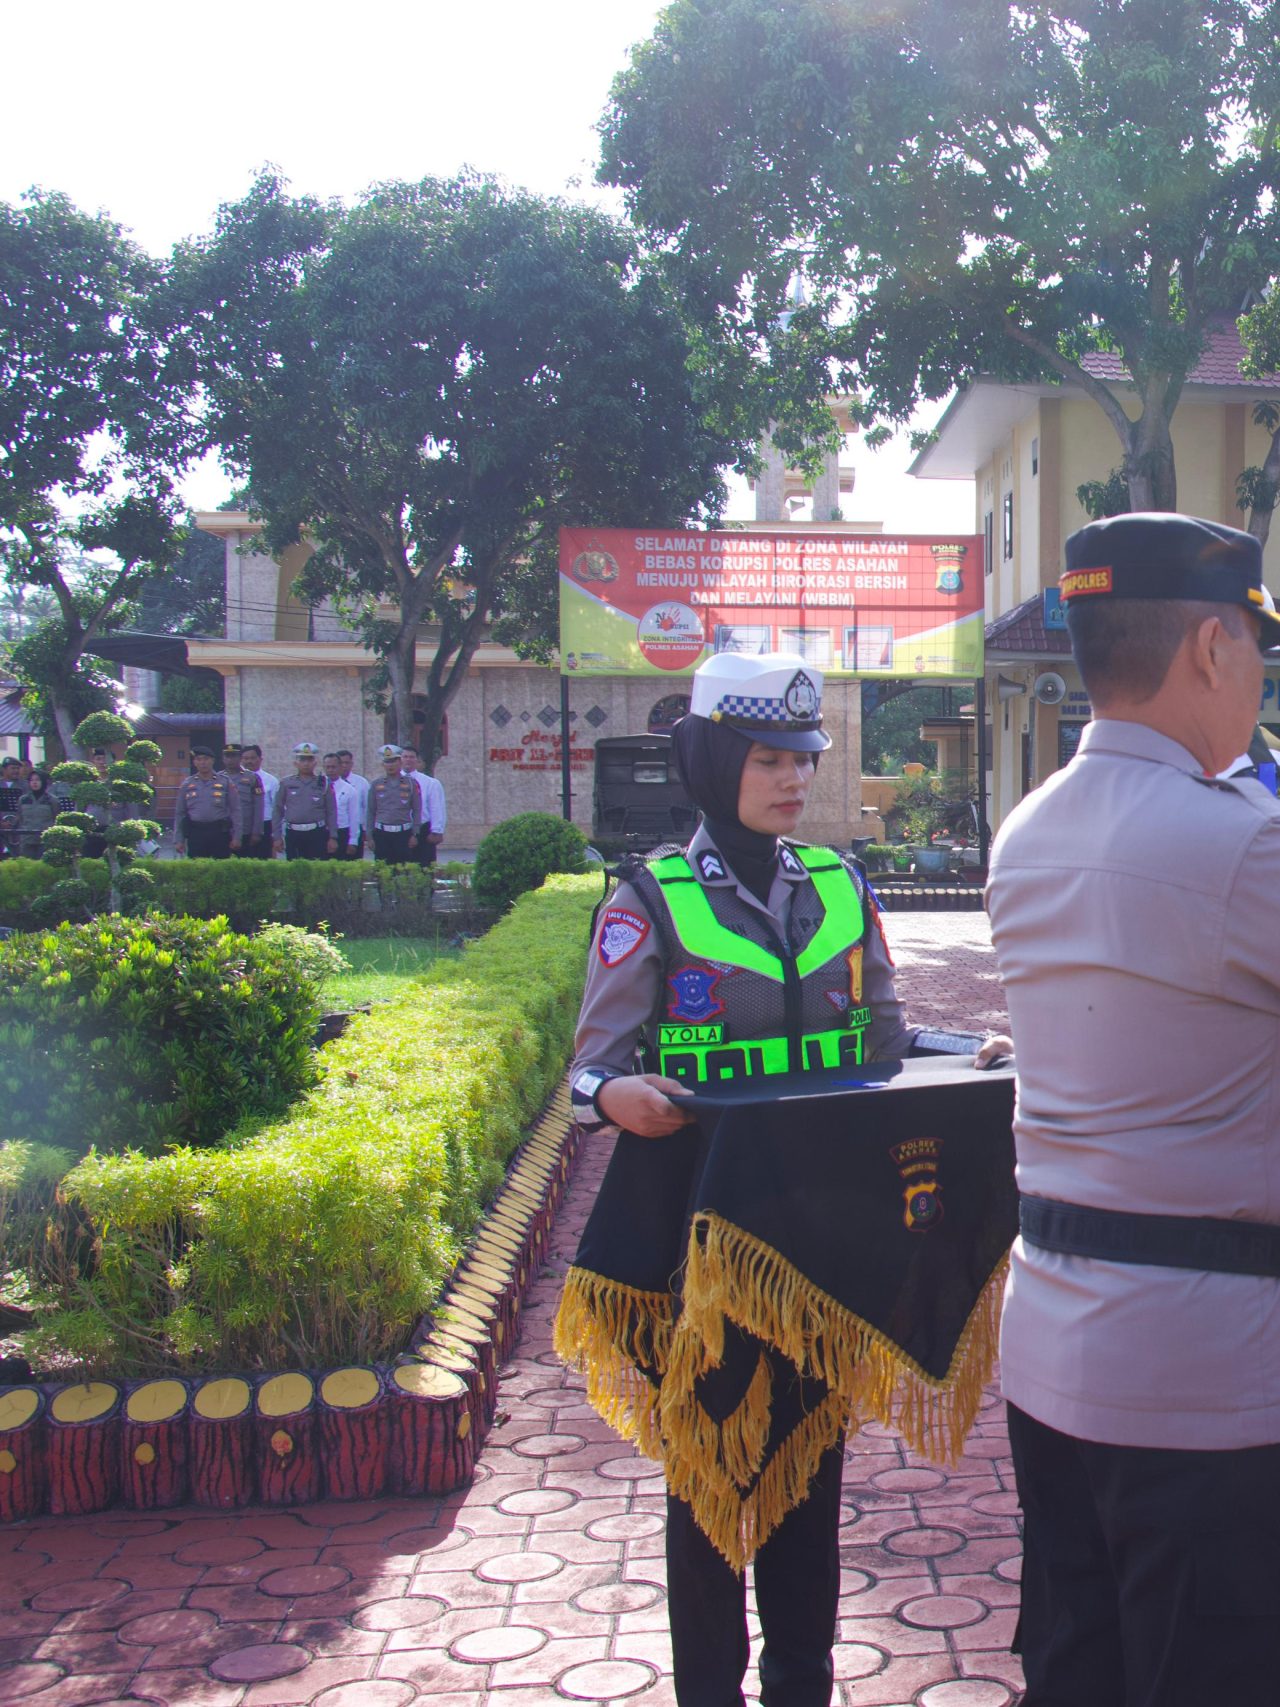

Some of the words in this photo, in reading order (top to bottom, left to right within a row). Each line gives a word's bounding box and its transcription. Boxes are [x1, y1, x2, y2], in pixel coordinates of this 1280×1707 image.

[634, 537, 706, 551] SELAMAT
[710, 538, 772, 552] DATANG
[775, 539, 791, 553] DI
[795, 539, 838, 554] ZONA
[841, 540, 909, 555] WILAYAH
[645, 555, 696, 569] BEBAS
[700, 556, 768, 570] KORUPSI
[772, 557, 833, 571] POLRES
[836, 558, 899, 572] ASAHAN
[636, 573, 699, 587] MENUJU
[702, 573, 767, 587] WILAYAH
[771, 574, 850, 588] BIROKRASI
[854, 575, 907, 589] BERSIH
[690, 591, 719, 605] DAN
[724, 591, 797, 606] MELAYANI
[801, 592, 855, 609] (WBBM)
[607, 911, 621, 919] LALU
[622, 913, 646, 930] LINTAS
[666, 1028, 718, 1043] YOLA
